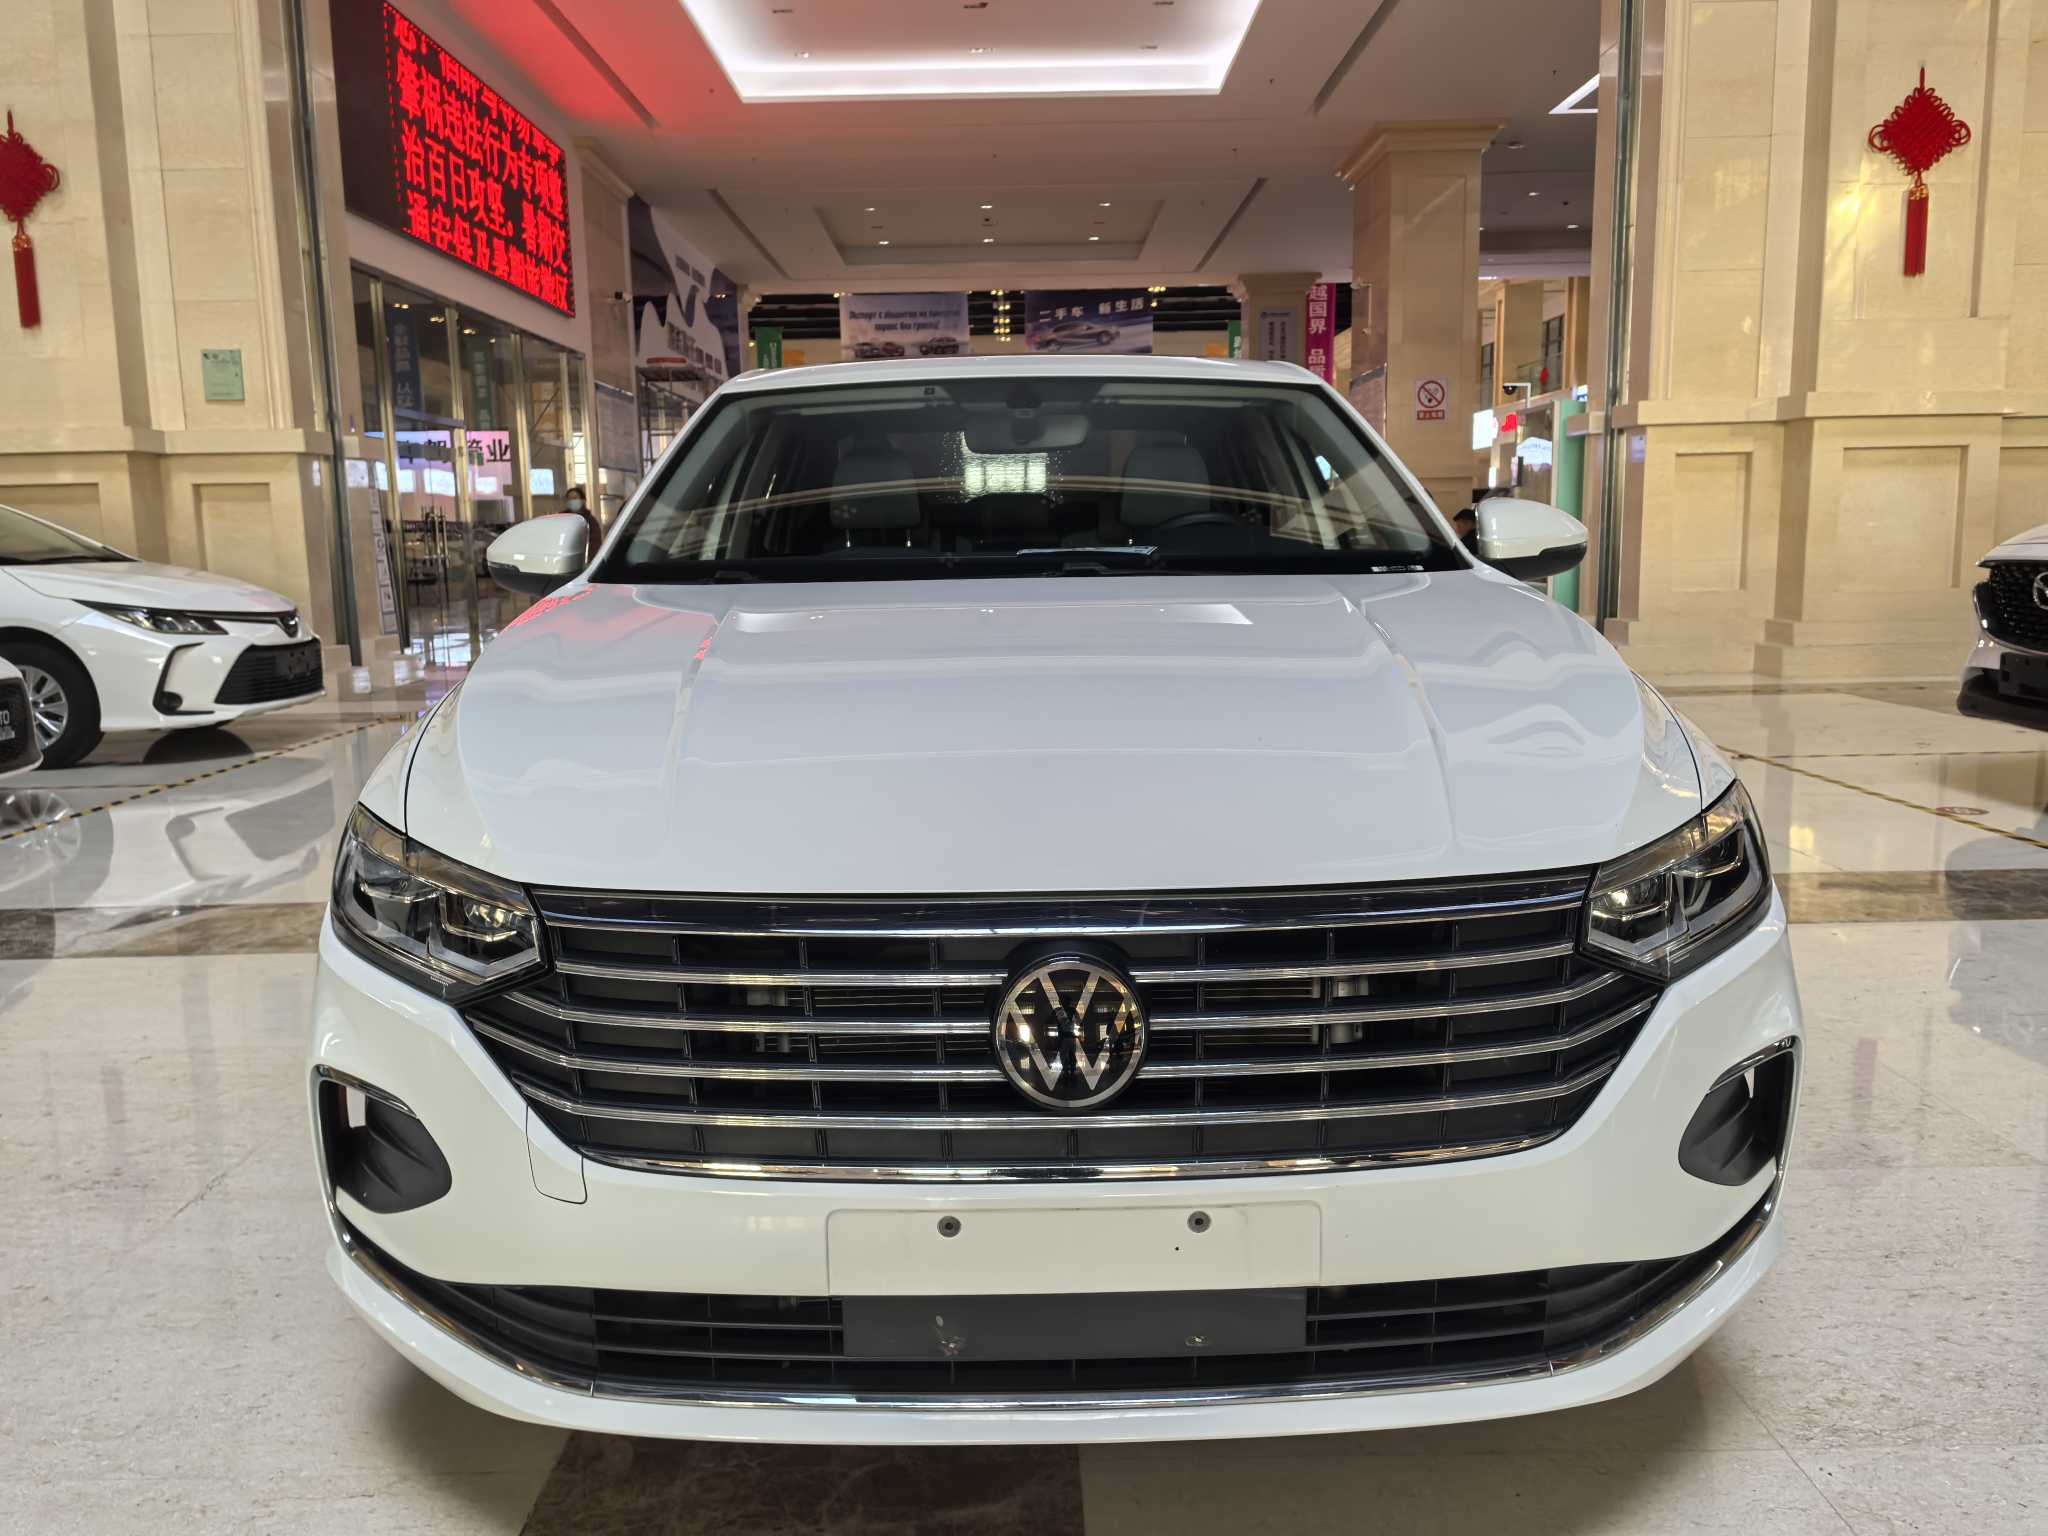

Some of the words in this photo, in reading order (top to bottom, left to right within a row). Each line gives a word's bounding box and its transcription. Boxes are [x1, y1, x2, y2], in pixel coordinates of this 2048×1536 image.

[1039, 306, 1084, 323] 二手车
[1098, 296, 1144, 315] 新生活
